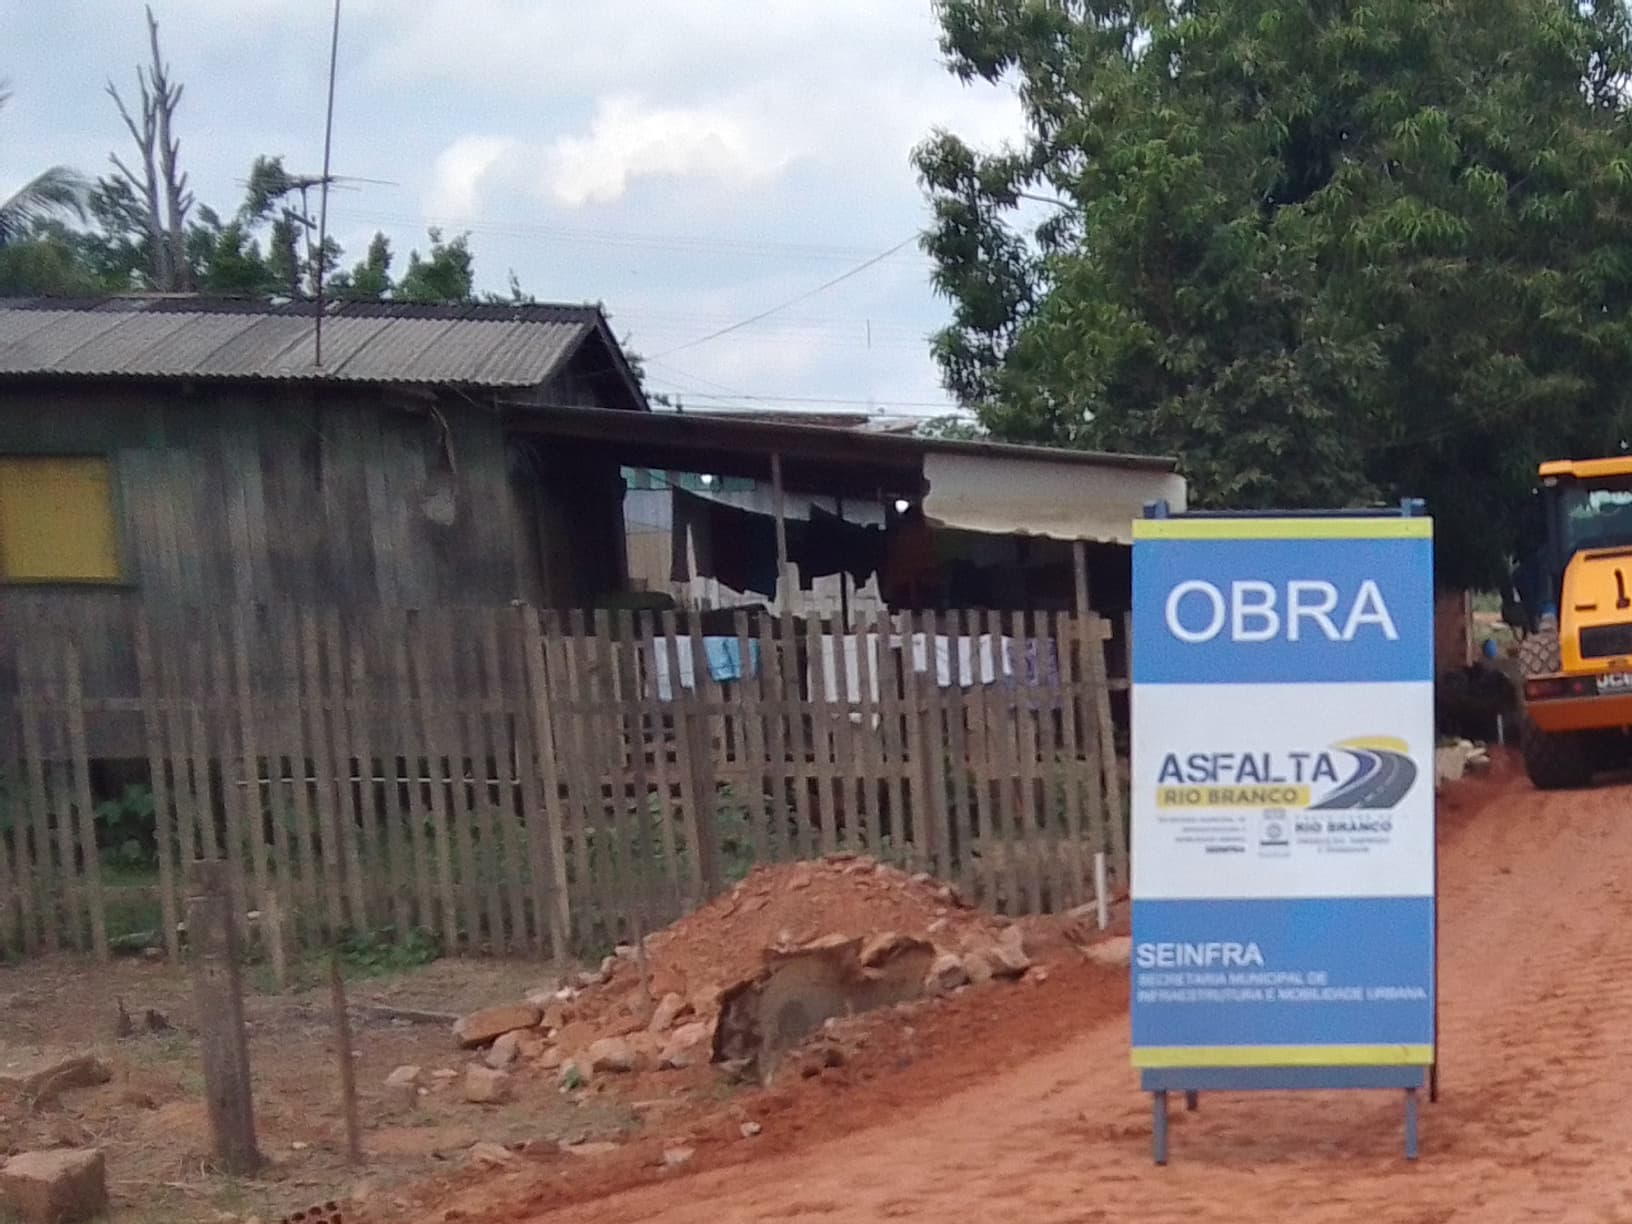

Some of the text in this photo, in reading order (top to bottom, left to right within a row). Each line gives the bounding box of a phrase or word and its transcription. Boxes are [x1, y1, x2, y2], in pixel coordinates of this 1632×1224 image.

[1165, 579, 1398, 642] OBRA
[1158, 753, 1338, 783] ASFALTA
[1164, 788, 1298, 805] RIO BRANCO
[1295, 821, 1393, 833] RIO BRANCO
[1136, 942, 1264, 968] SEINFRA
